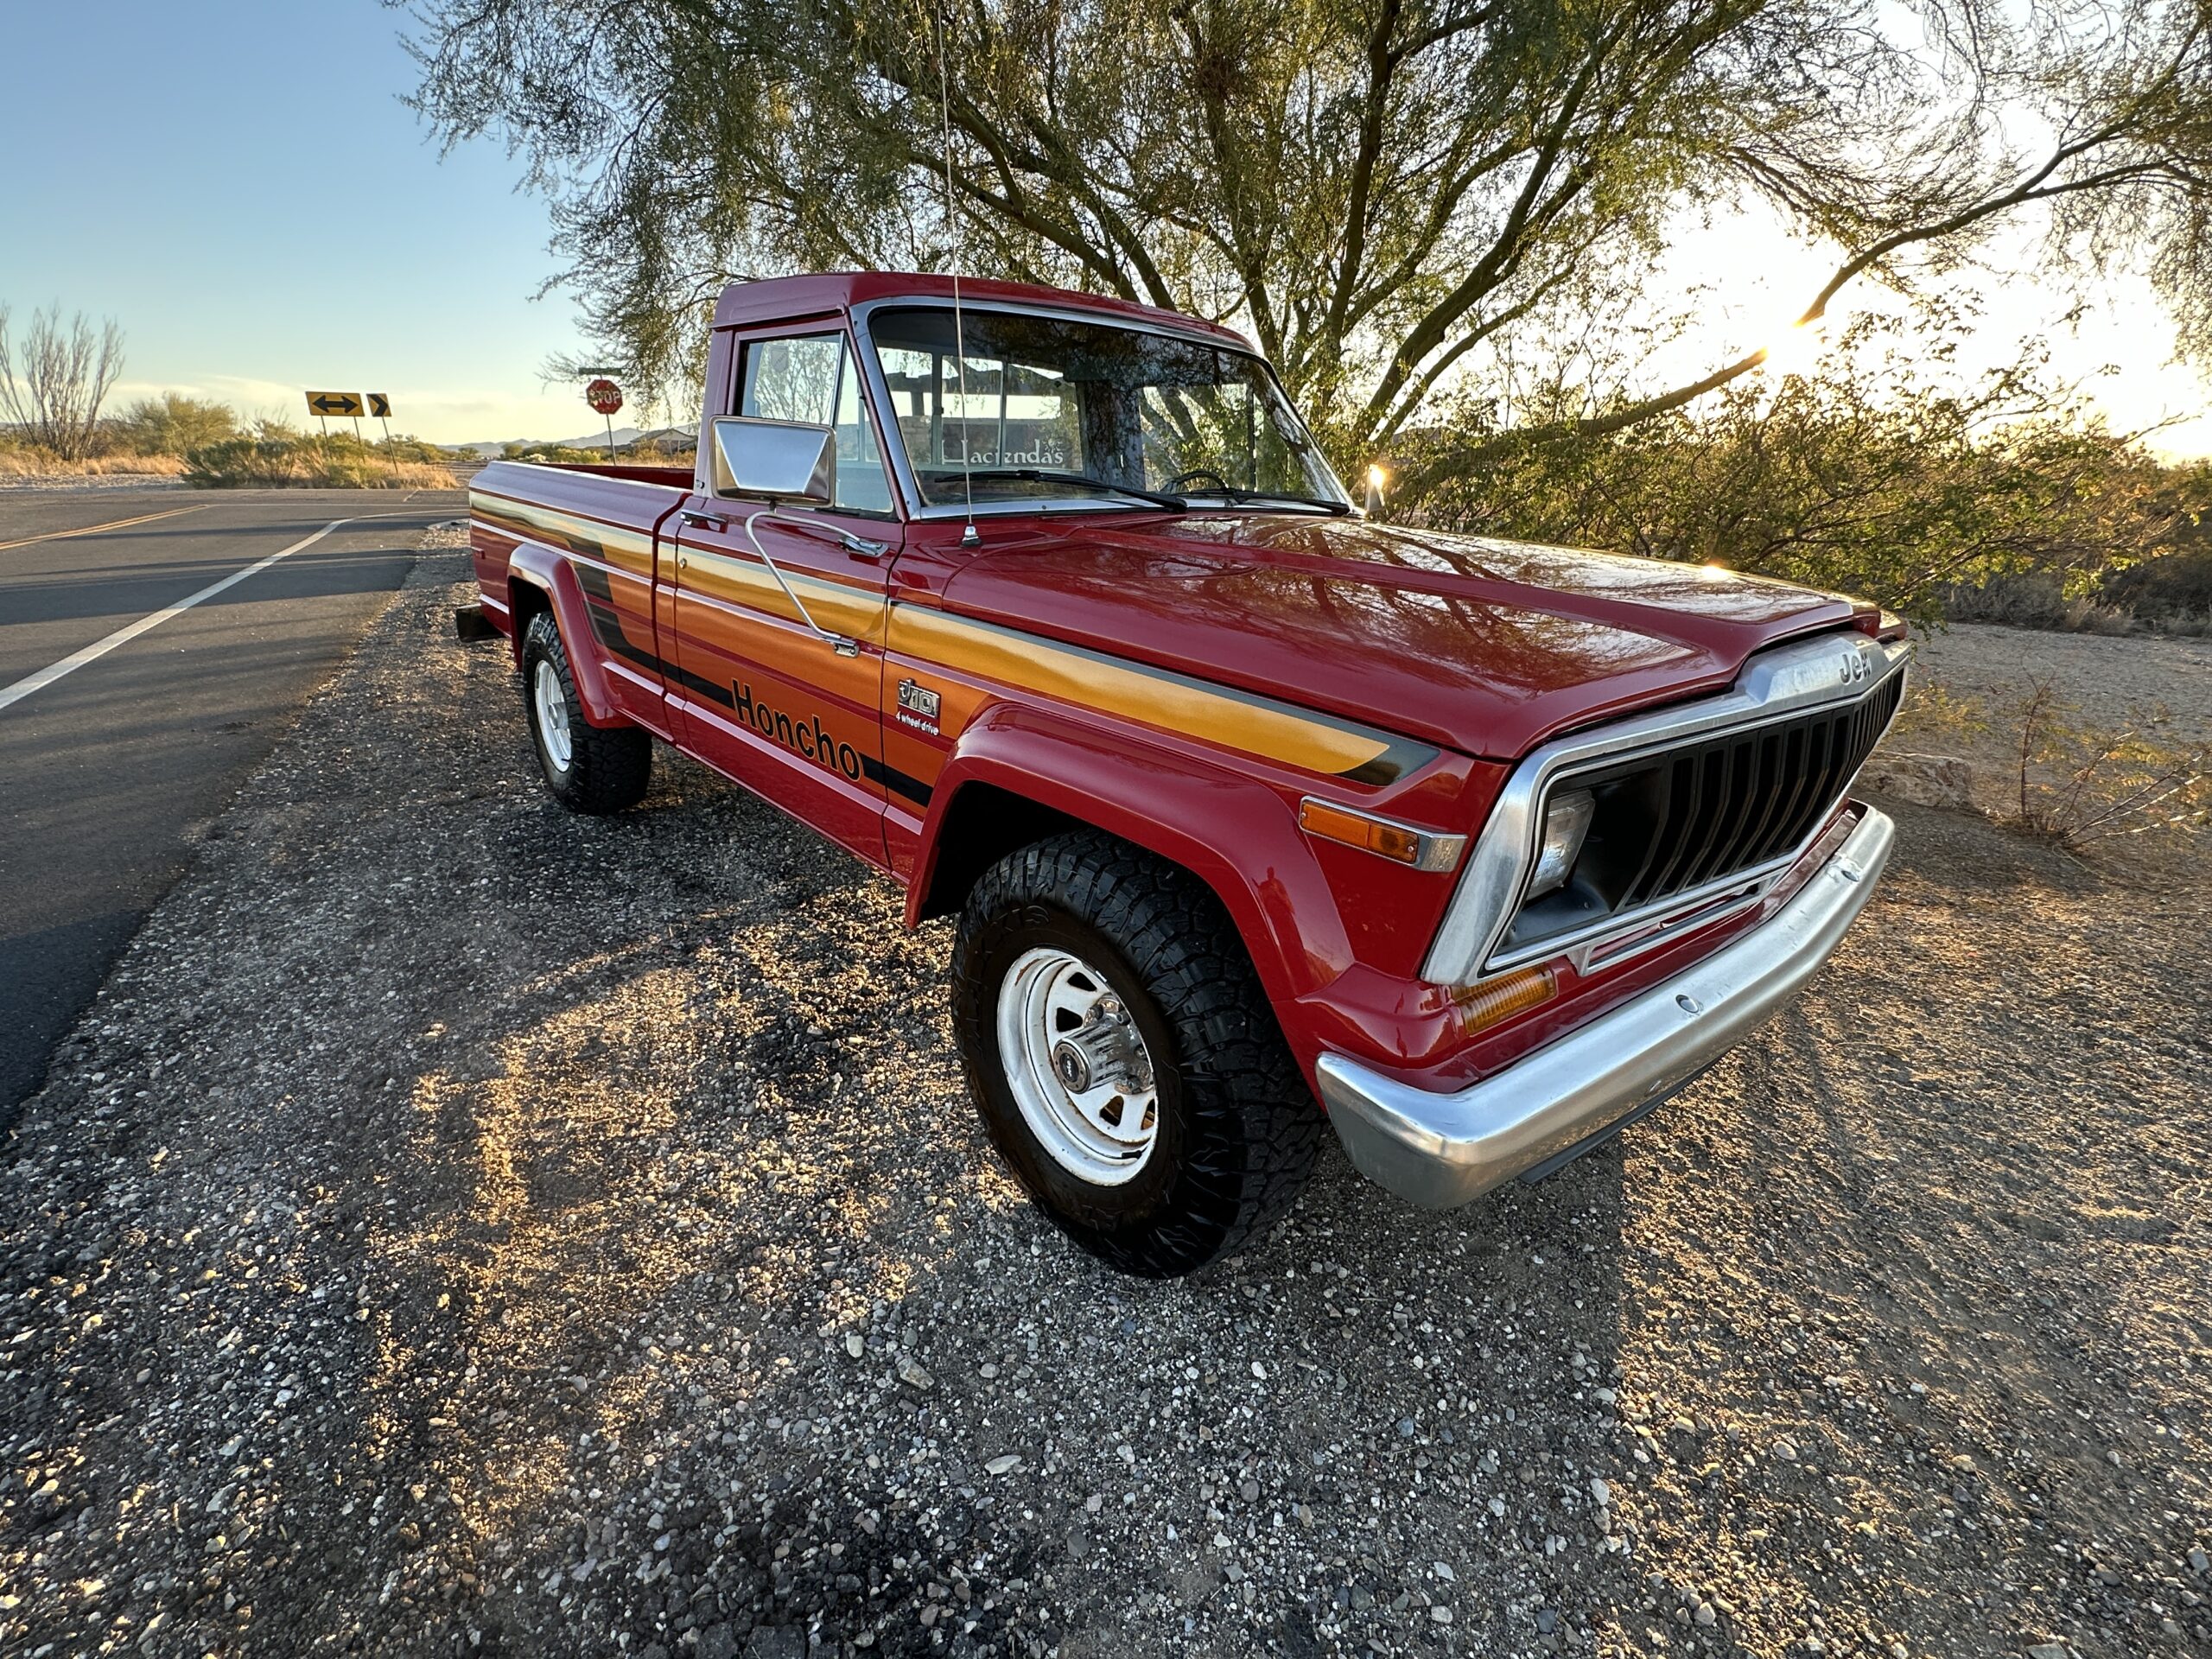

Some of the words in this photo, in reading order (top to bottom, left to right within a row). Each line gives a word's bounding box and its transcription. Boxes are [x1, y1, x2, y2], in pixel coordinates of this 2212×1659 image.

[732, 677, 861, 782] Honcho
[896, 711, 901, 721] 4
[901, 715, 920, 728] wheel
[921, 721, 939, 736] drive
